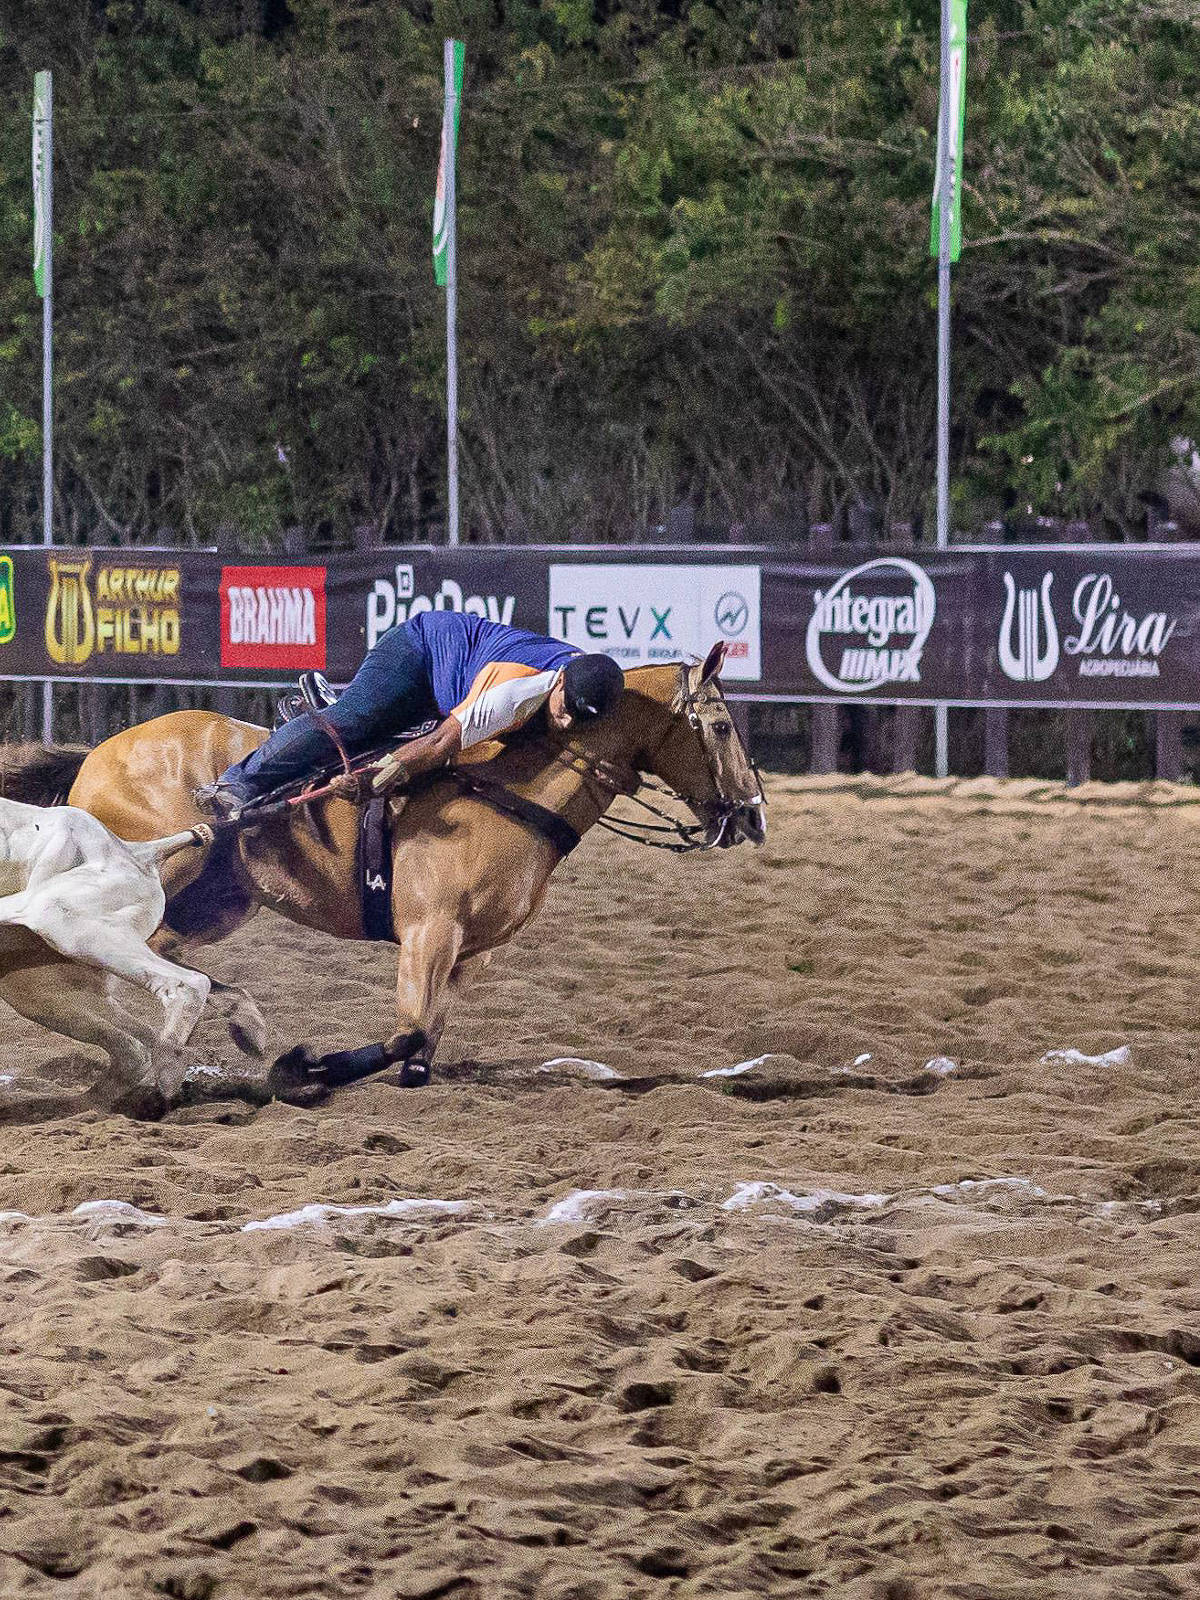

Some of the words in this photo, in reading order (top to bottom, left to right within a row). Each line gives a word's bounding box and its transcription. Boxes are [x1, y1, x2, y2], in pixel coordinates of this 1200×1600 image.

[97, 608, 180, 655] FILHO
[228, 586, 316, 645] BRAHMA
[554, 606, 672, 640] TEVX
[814, 586, 927, 647] integral
[1063, 573, 1177, 656] Lira
